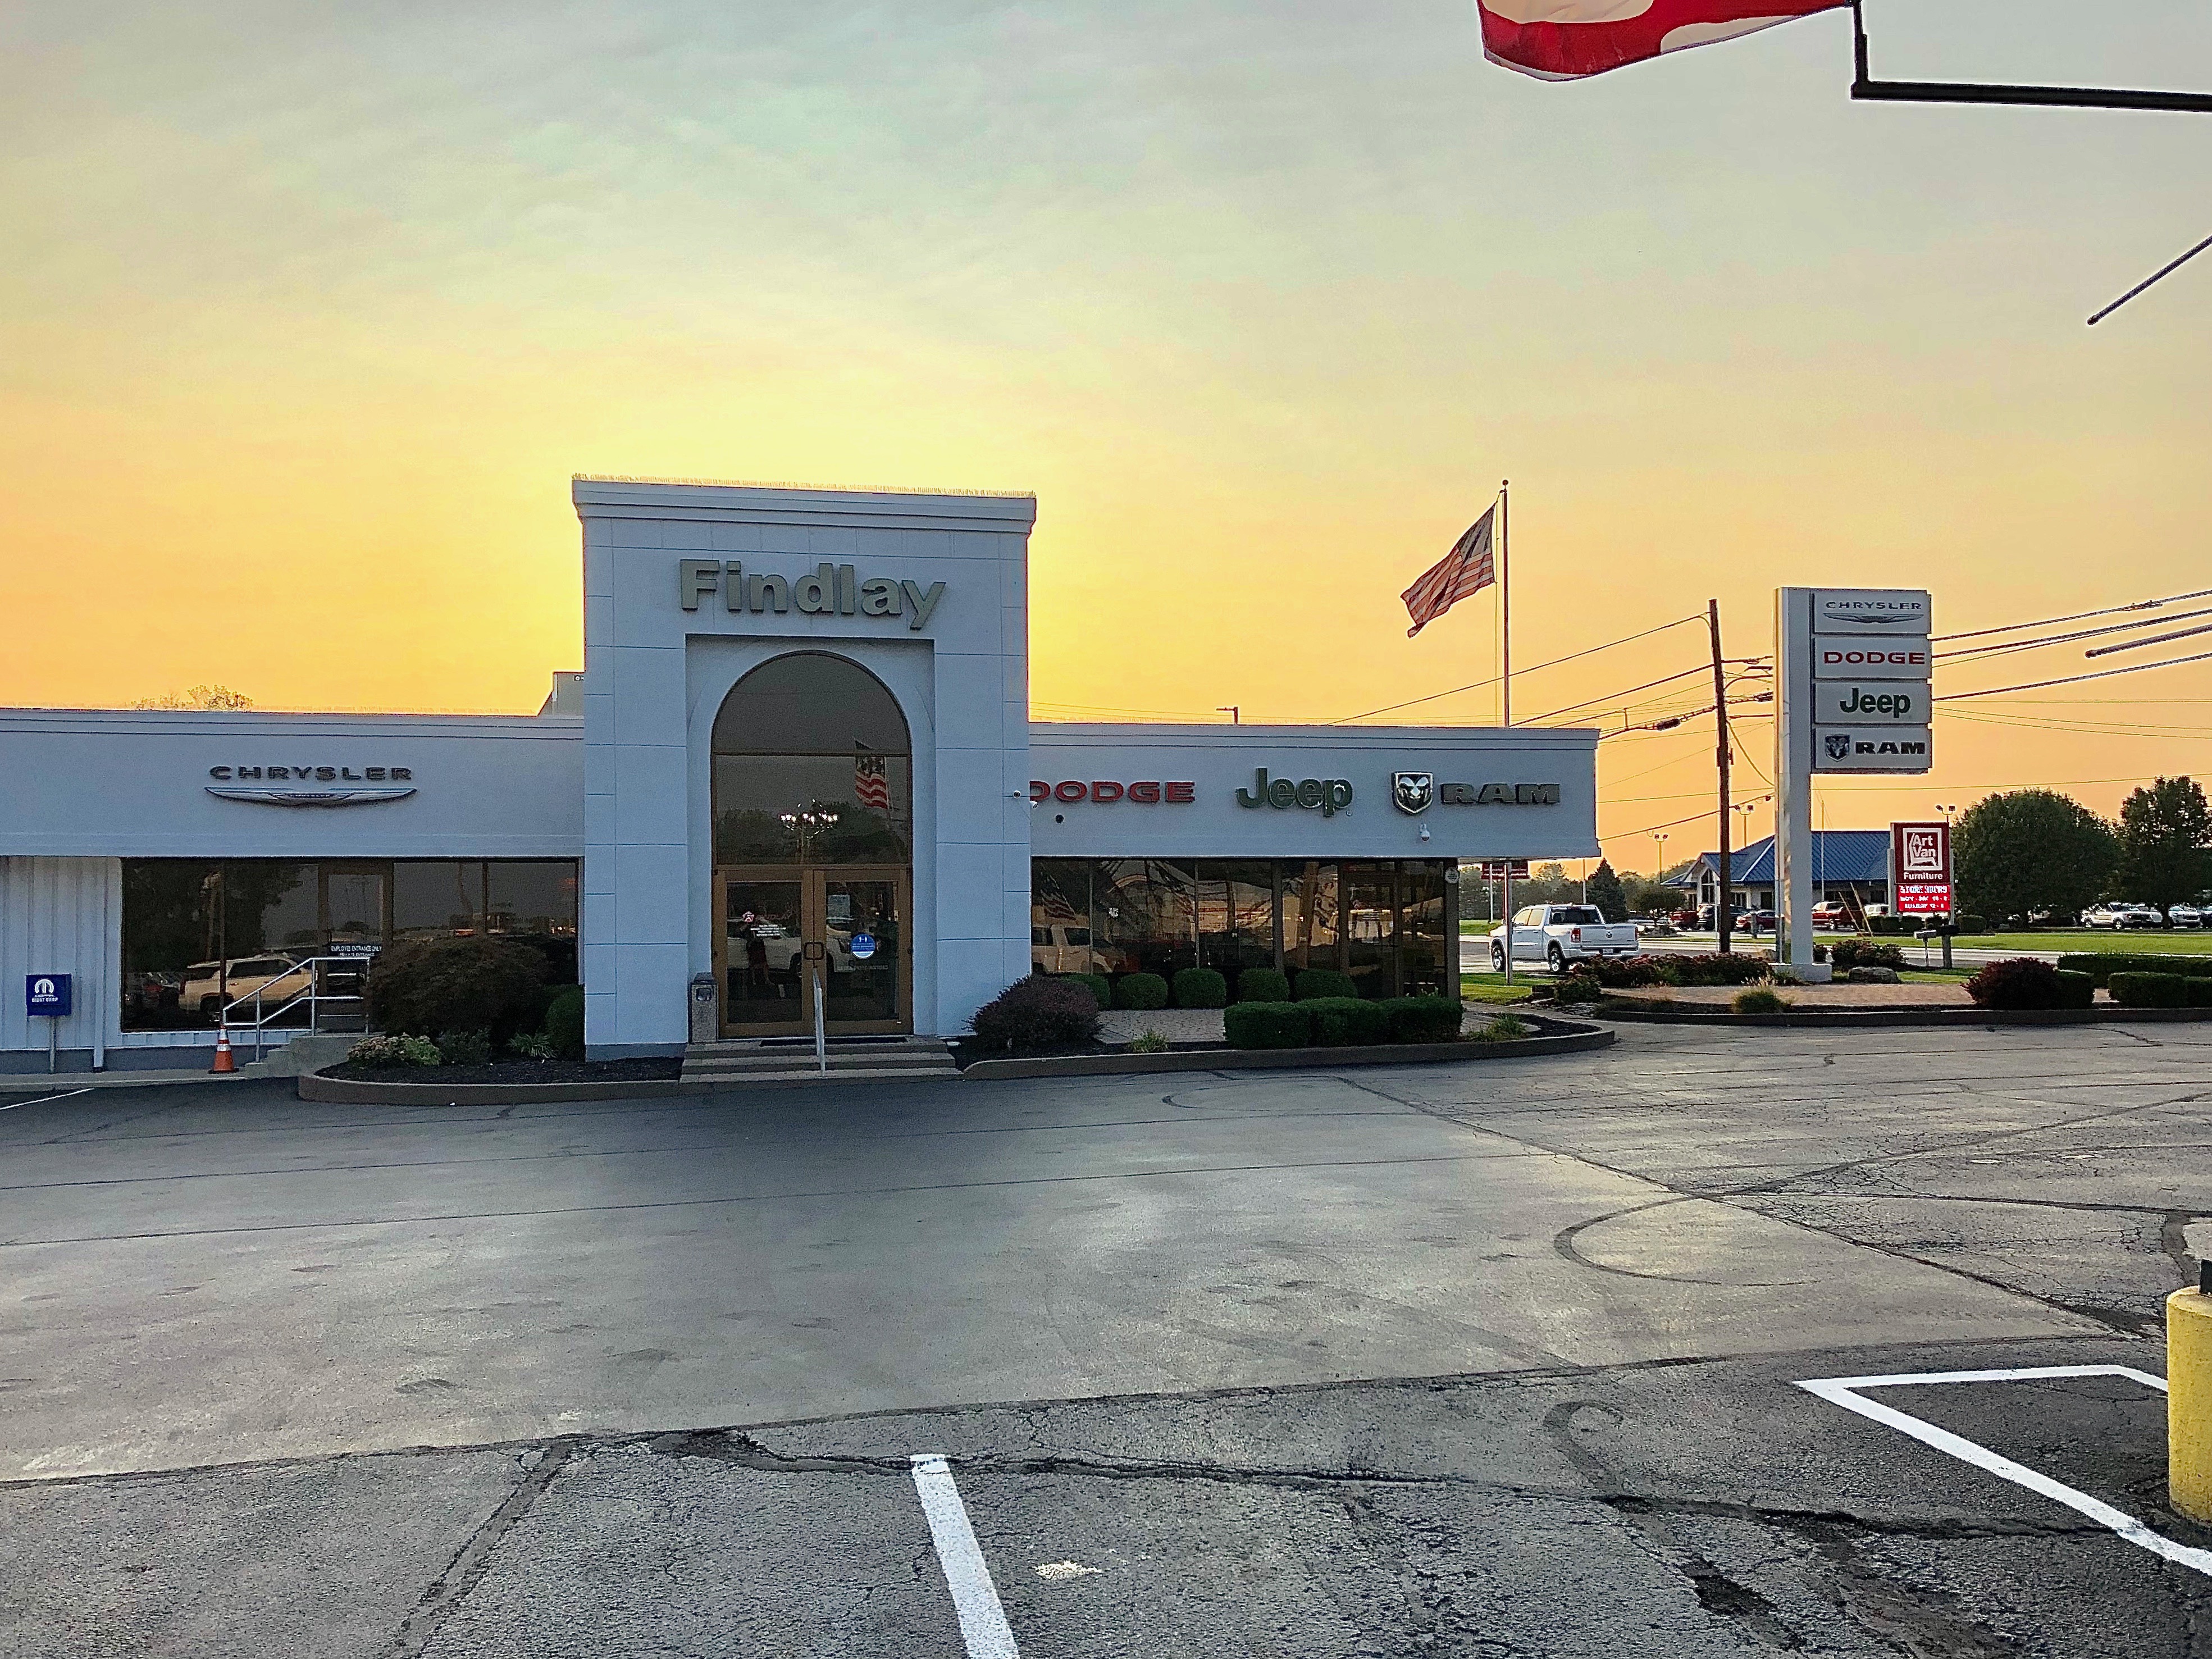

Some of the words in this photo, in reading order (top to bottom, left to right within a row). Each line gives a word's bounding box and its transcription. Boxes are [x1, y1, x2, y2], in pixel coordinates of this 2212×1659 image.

[680, 559, 946, 630] Findlay
[1824, 651, 1924, 664] DODGE
[1840, 687, 1910, 718] Jeep
[1855, 742, 1925, 754] RAM
[209, 766, 412, 780] CHRYSLER
[1237, 767, 1353, 817] Jeep
[1440, 783, 1560, 803] RAM
[1913, 835, 1933, 846] Art
[1913, 846, 1936, 858] Van
